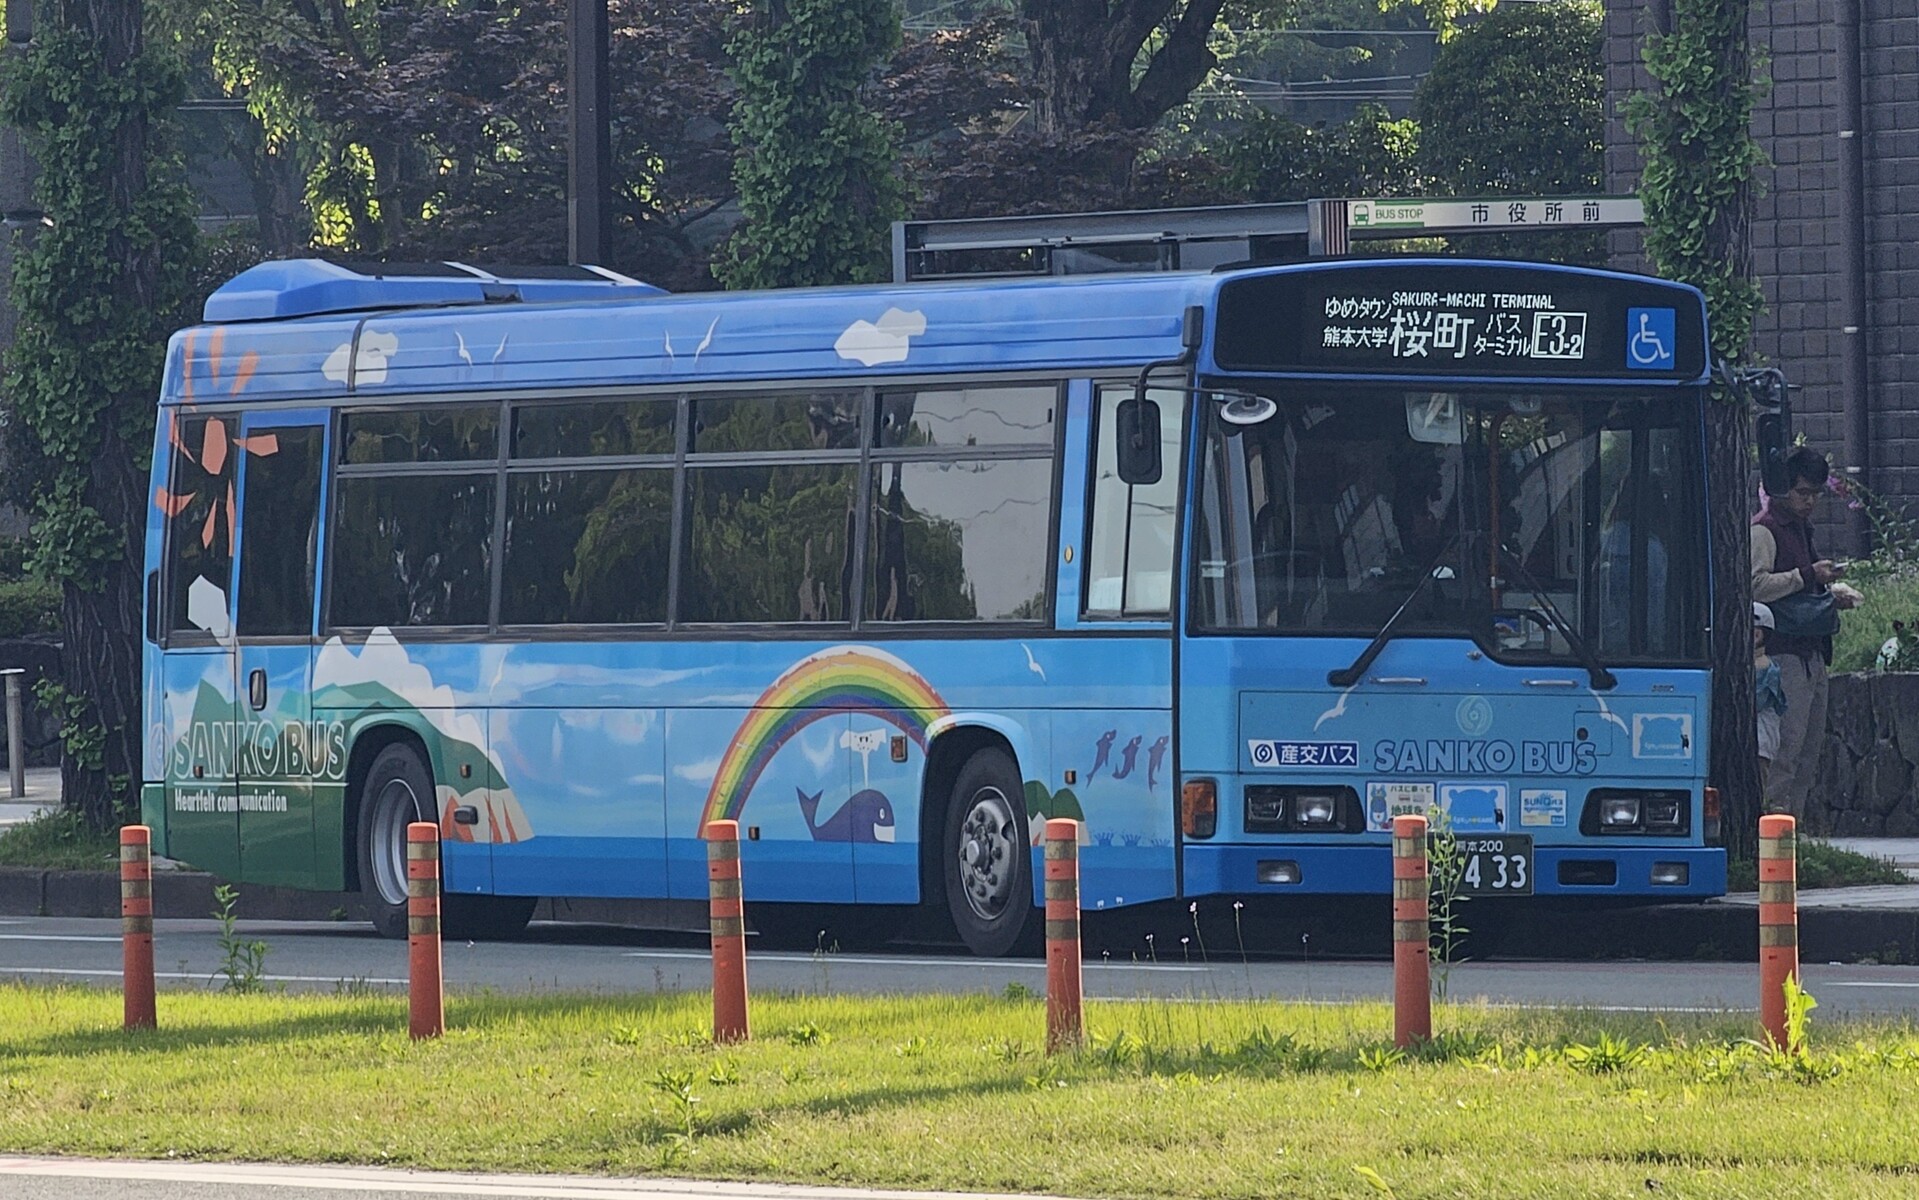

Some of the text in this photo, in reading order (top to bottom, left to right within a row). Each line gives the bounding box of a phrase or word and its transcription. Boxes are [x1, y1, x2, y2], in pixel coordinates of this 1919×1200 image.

[1375, 208, 1424, 219] BUS STOP
[1471, 202, 1600, 224] 市役所前
[1325, 296, 1392, 319] ゆめタウン
[1391, 291, 1556, 309] SAKURA-MACHI TERMINAL
[1388, 308, 1475, 359] 桜町
[1486, 312, 1522, 334] バス
[1322, 325, 1388, 348] 熊本大学
[1473, 334, 1532, 356] ターミナル
[174, 720, 346, 780] SANKO BUS
[1281, 745, 1355, 764] 産交バス
[1374, 739, 1598, 775] SANKO BUS
[174, 788, 215, 812] Heartfelt
